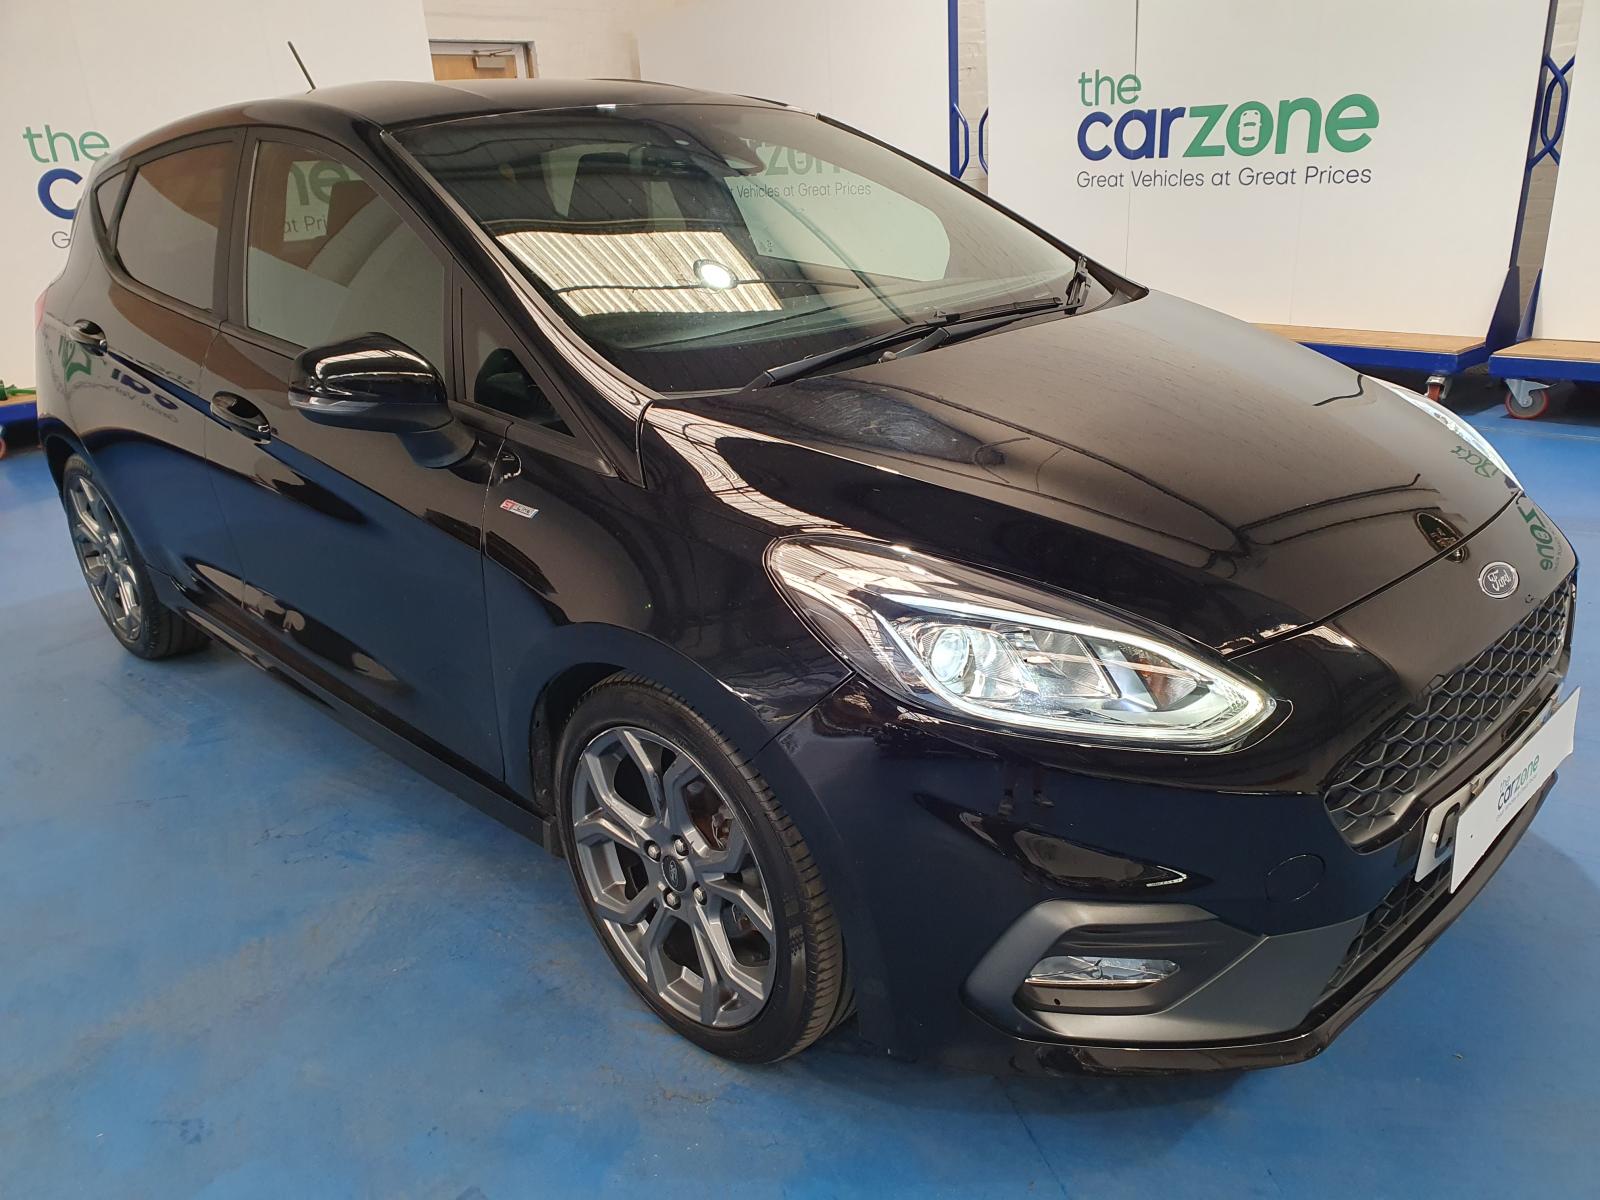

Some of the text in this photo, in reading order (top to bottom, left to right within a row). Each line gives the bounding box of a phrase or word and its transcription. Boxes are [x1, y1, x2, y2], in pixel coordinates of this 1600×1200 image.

[1077, 69, 1142, 107] the
[22, 124, 110, 164] the
[1076, 93, 1380, 161] carzone
[736, 184, 780, 199] Vehicles
[783, 183, 796, 196] at
[797, 182, 832, 197] Great
[834, 181, 872, 196] Prices
[1076, 165, 1373, 189] Great Vehicles at Great Prices
[1497, 754, 1540, 811] carzone
